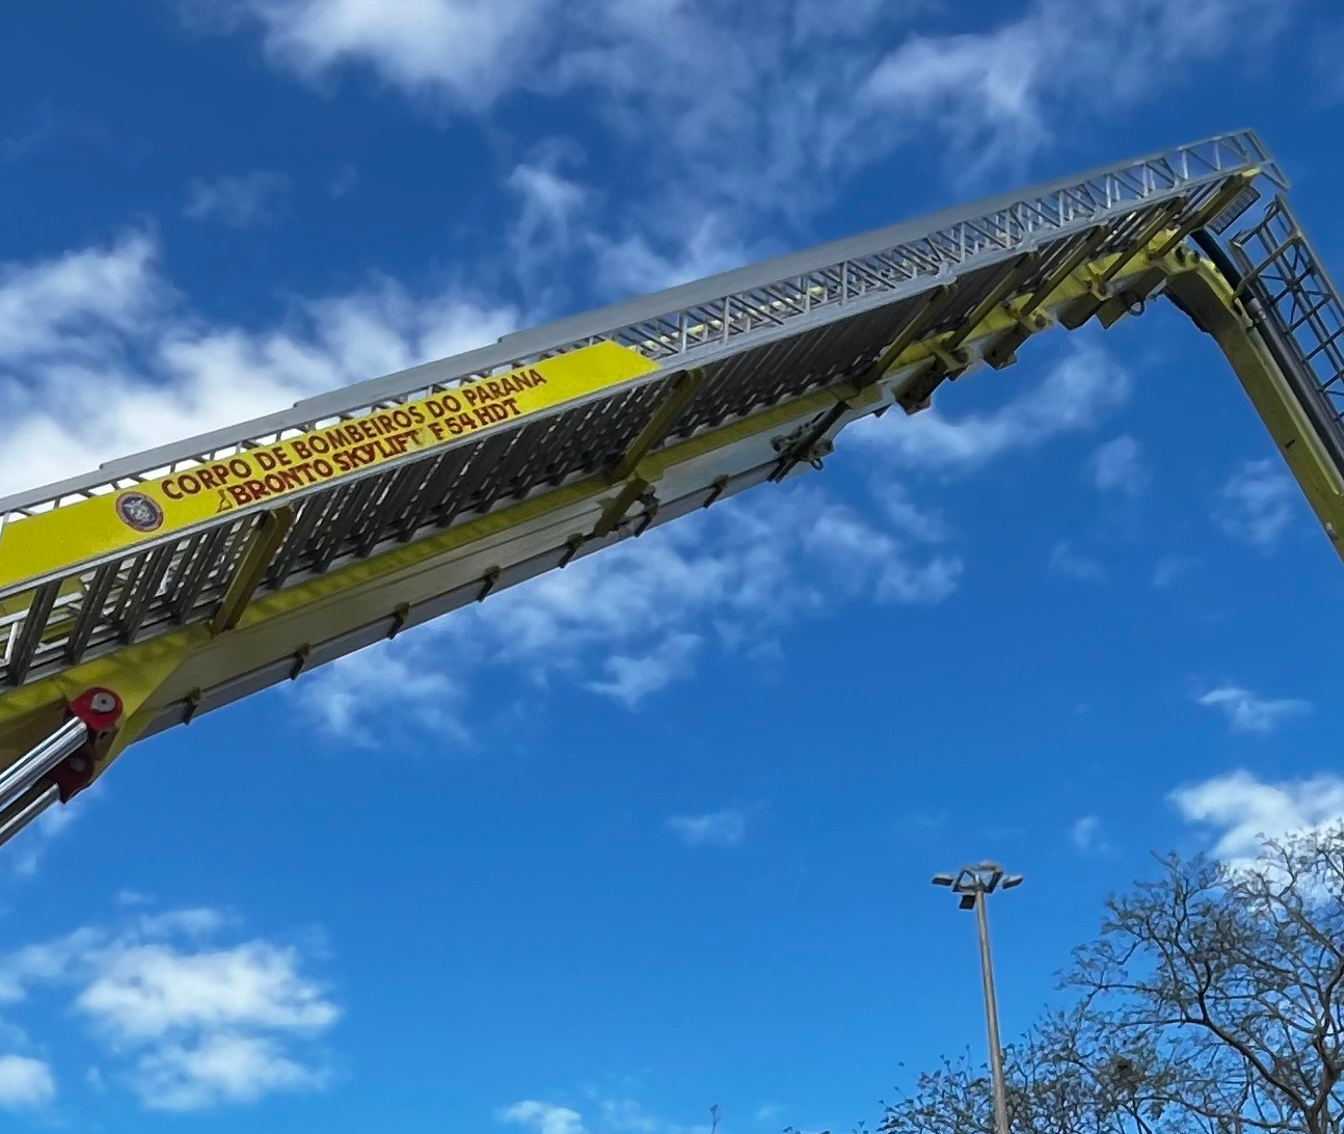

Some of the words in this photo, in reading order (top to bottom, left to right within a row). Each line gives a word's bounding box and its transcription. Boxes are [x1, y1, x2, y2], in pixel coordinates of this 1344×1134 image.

[161, 458, 252, 499] CORPO
[253, 446, 292, 471] DE
[291, 405, 425, 459] BOMBEIROS
[425, 395, 462, 419] DO
[227, 459, 334, 507] BRONTO
[332, 429, 422, 472] SKYLIFT
